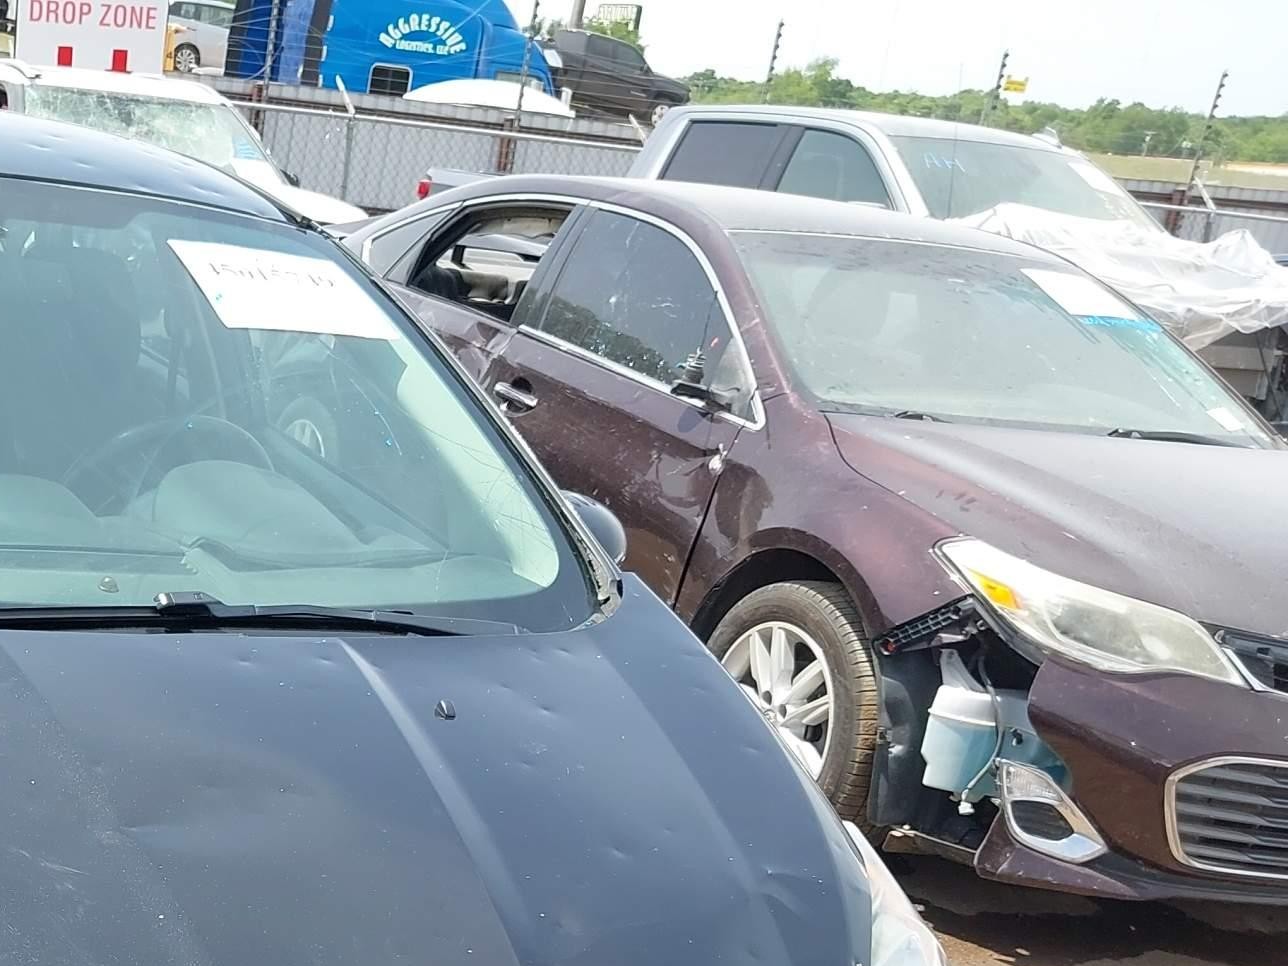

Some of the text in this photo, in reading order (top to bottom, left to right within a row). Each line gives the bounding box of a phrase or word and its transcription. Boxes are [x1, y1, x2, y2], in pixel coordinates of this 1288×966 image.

[29, 0, 157, 29] DROP ZONE
[379, 13, 466, 54] AGGRESSIVE
